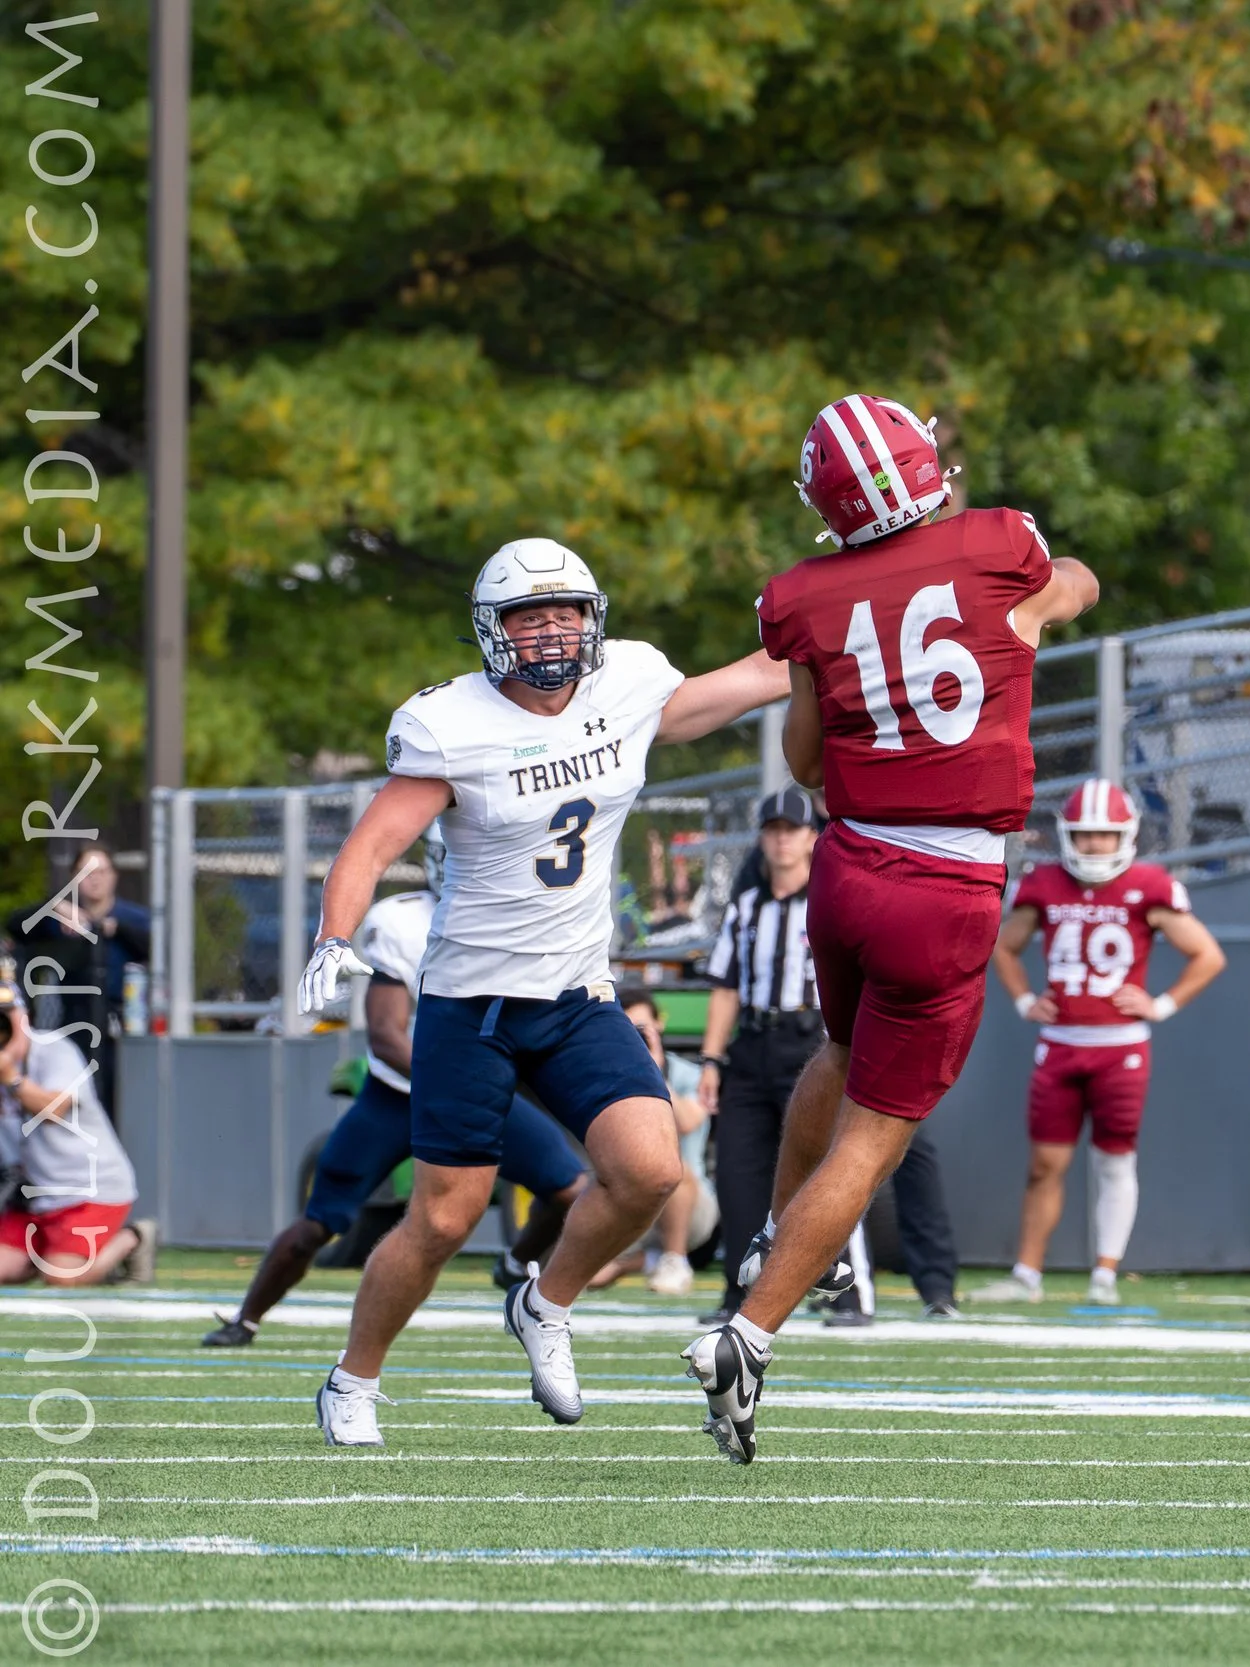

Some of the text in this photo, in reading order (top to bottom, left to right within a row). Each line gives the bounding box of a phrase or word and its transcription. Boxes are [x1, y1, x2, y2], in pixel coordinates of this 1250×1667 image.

[853, 499, 867, 513] 16
[875, 475, 889, 487] C2P
[872, 503, 930, 536] R.E.A.L.
[843, 581, 985, 751] 16
[508, 739, 623, 797] TRINITY
[533, 796, 597, 890] 3
[1048, 921, 1135, 997] 49
